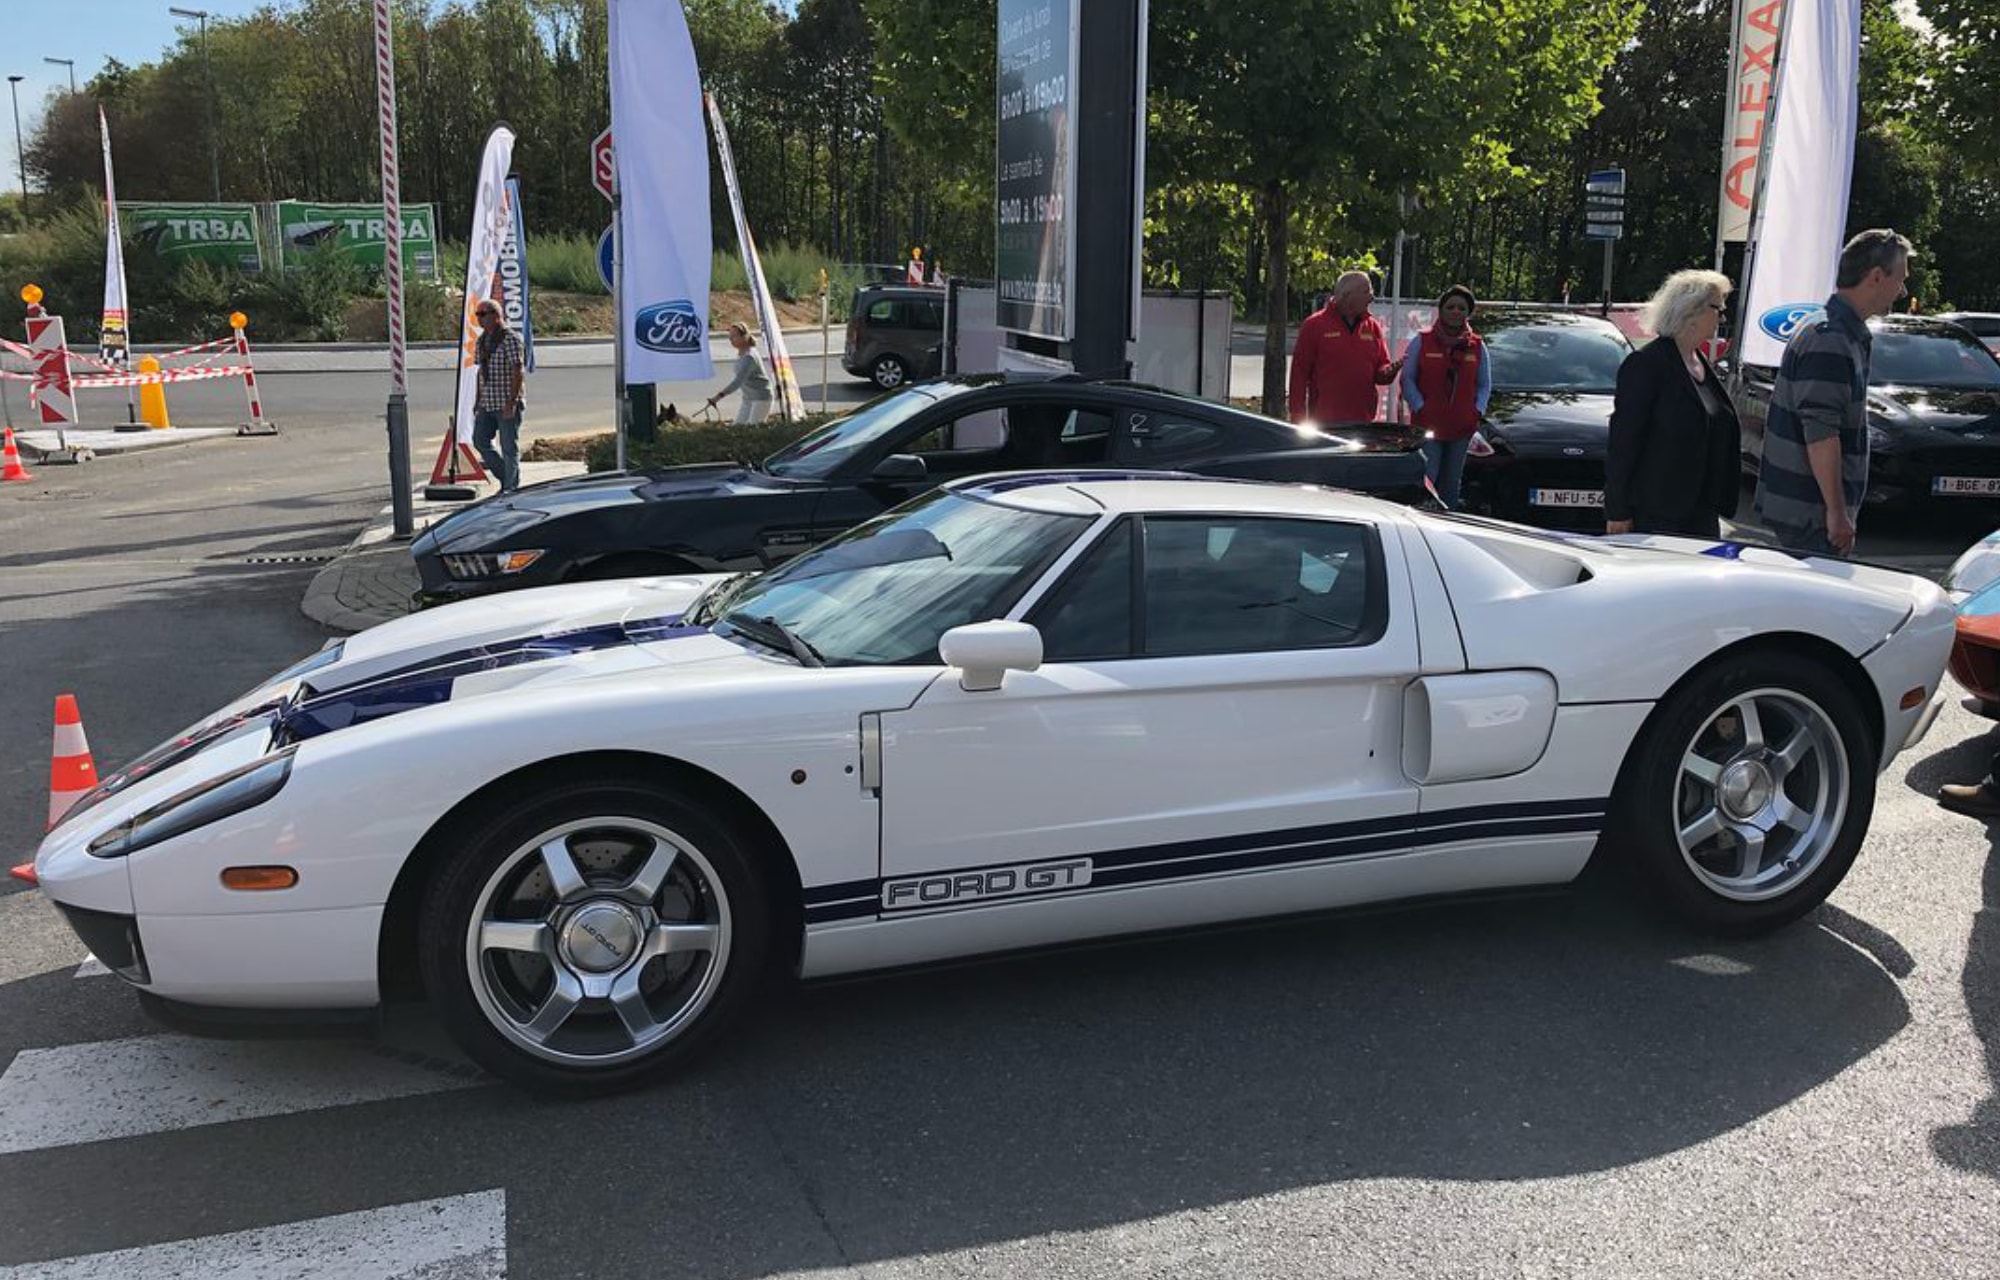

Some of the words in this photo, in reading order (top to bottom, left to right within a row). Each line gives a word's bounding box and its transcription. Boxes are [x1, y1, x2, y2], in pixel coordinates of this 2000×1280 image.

[167, 218, 251, 241] TRBA
[648, 309, 699, 344] For
[888, 869, 1016, 906] FORD
[1025, 860, 1087, 889] GT
